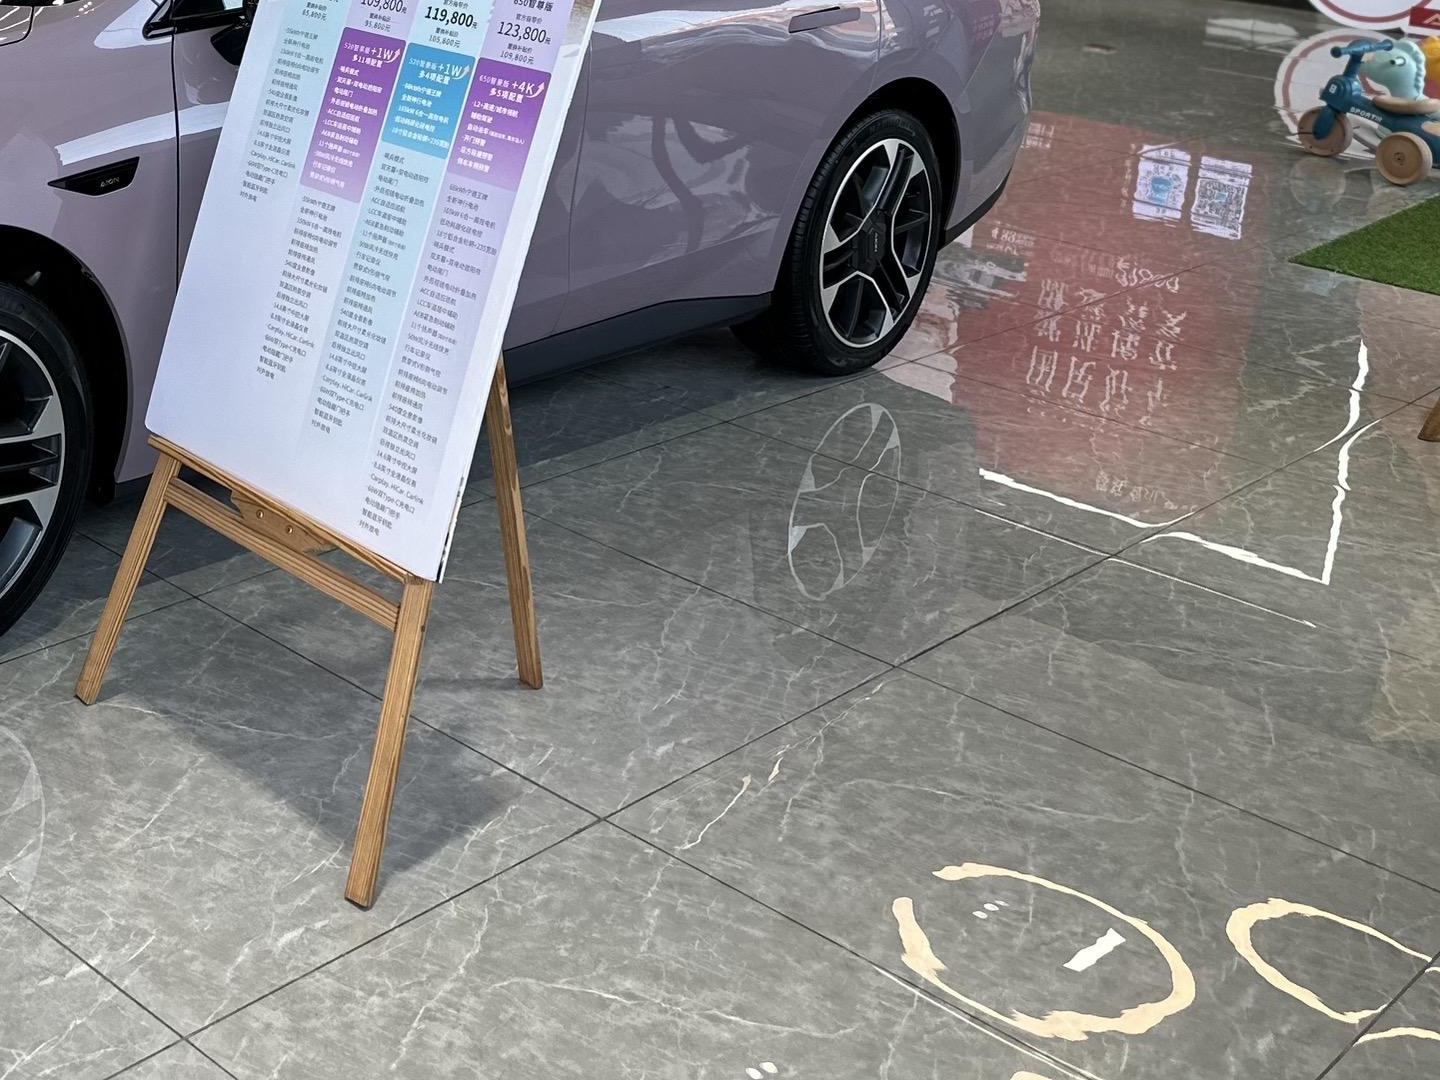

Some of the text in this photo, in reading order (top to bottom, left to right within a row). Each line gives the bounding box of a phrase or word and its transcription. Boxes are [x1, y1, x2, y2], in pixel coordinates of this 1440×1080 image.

[422, 5, 480, 32] 119,800元
[495, 19, 554, 47] 123,800元
[488, 86, 525, 104] 多5项配置
